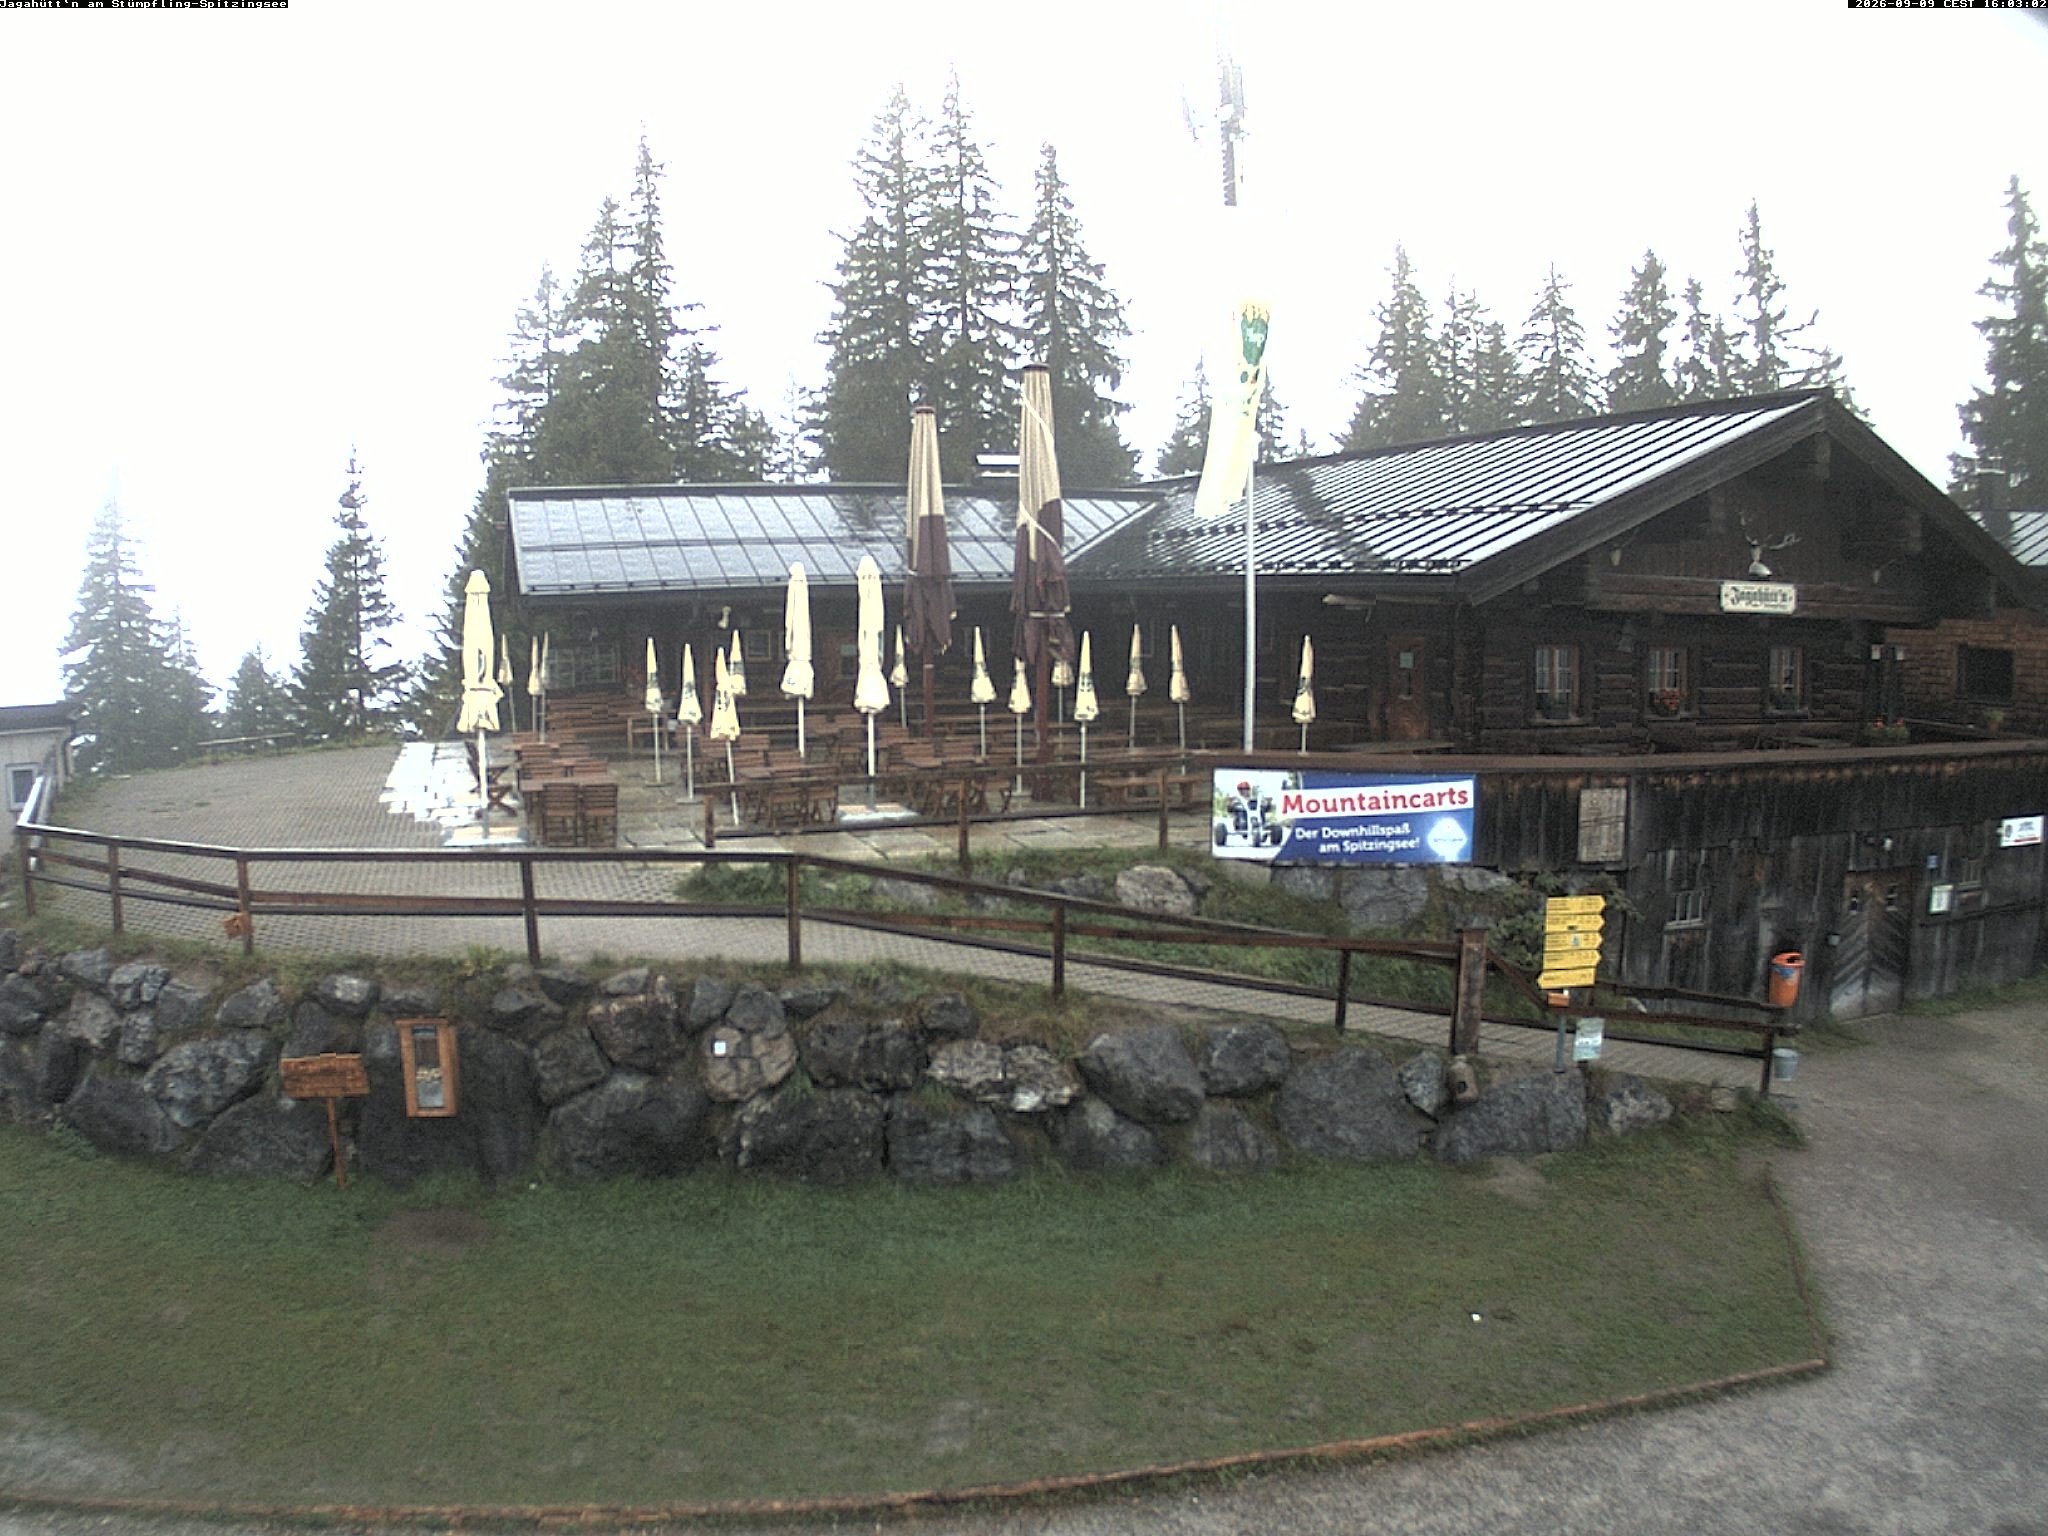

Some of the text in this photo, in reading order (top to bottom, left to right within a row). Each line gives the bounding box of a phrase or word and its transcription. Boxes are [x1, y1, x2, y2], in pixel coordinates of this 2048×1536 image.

[1282, 787, 1469, 814] Mountaincarts
[1295, 822, 1411, 840] Der Downhillspaß
[1318, 837, 1421, 855] am Spitzingsee!
